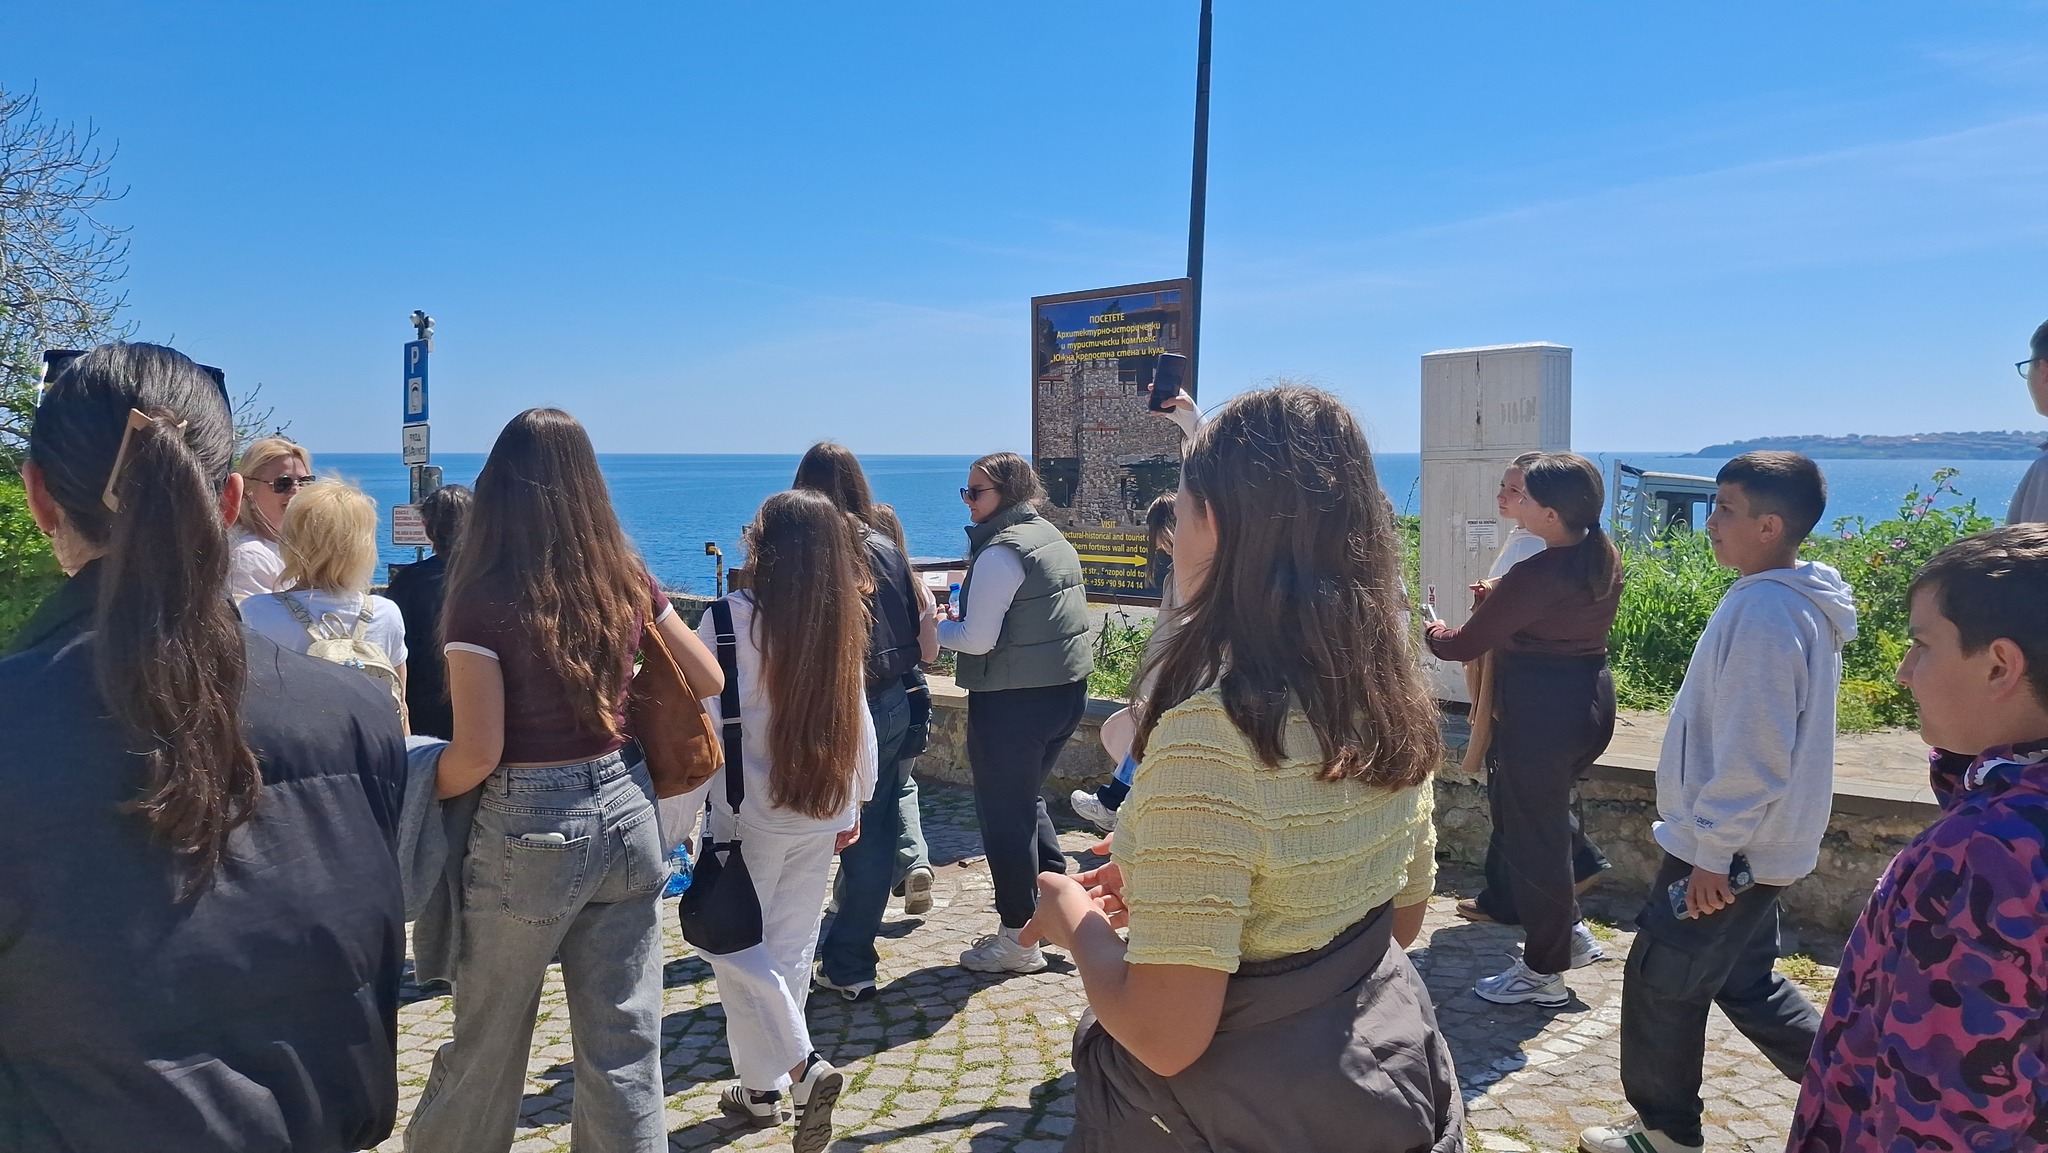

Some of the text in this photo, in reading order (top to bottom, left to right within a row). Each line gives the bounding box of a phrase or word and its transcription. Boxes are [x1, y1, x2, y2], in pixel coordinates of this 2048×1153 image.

[1089, 313, 1125, 323] ПОСЕТЕТЕ
[1056, 321, 1161, 338] Архитектурно-исторически
[1067, 337, 1120, 350] туристически
[1121, 336, 1157, 345] комплекс
[411, 346, 420, 374] P
[1076, 350, 1115, 362] крепостна
[1116, 348, 1140, 357] стена
[1101, 520, 1117, 529] VISIT
[1125, 533, 1145, 541] tourist
[1088, 542, 1111, 552] fortress
[1112, 543, 1125, 553] wall
[1126, 544, 1138, 553] and
[1126, 568, 1137, 577] old
[1090, 578, 1105, 587] +359
[1117, 580, 1126, 588] 94
[1127, 581, 1135, 589] 74
[1135, 582, 1144, 590] 14
